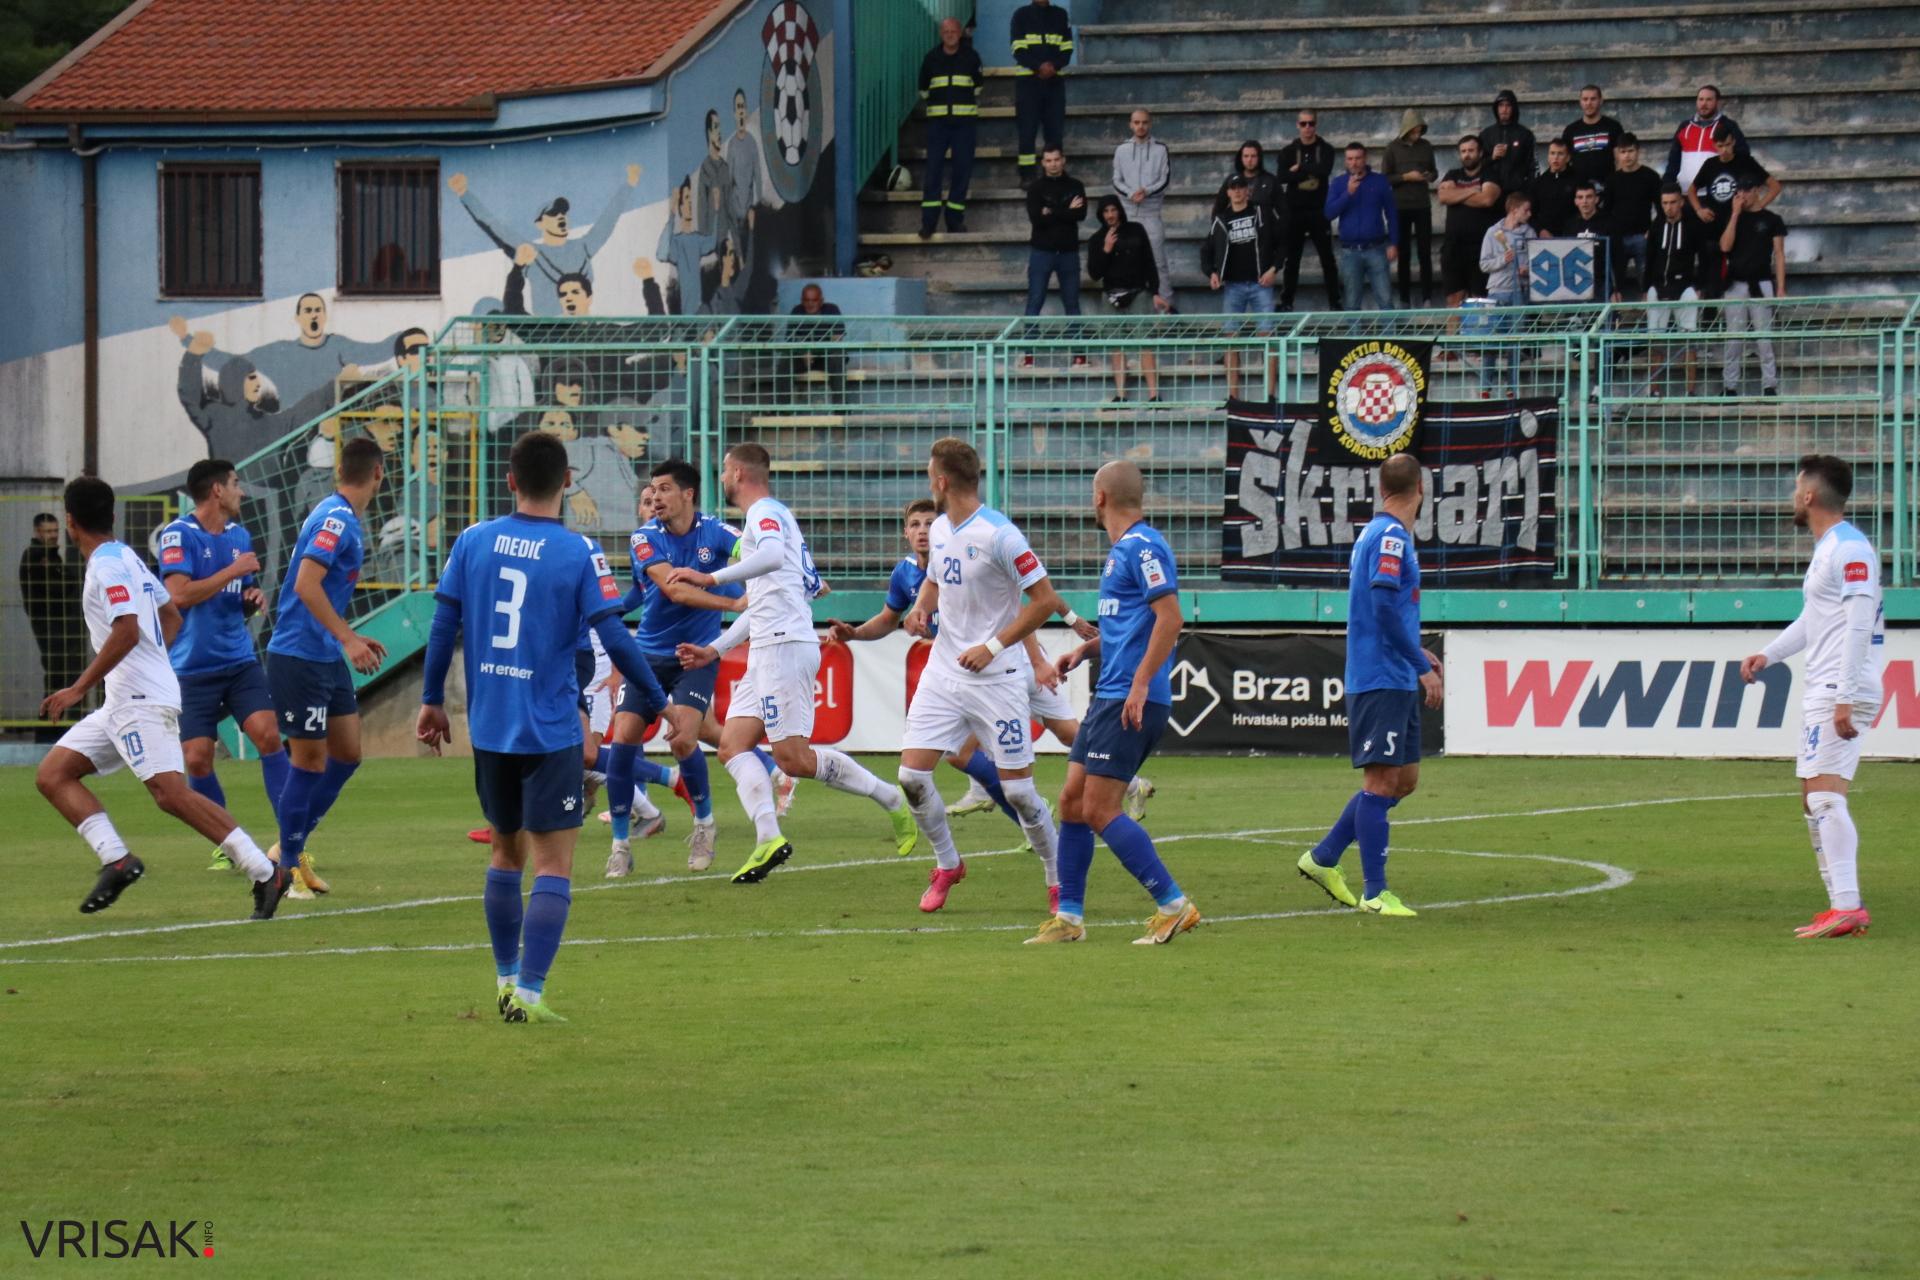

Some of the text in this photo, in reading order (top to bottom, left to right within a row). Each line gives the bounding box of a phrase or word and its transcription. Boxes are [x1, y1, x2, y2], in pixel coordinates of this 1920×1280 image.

[1530, 246, 1594, 298] 96
[1328, 368, 1345, 395] POD
[1340, 341, 1380, 369] SVETIM
[1328, 415, 1343, 434] DO
[494, 534, 546, 560] MEDIĆ
[943, 556, 962, 585] 29
[492, 566, 528, 650] 3
[480, 662, 495, 674] HT
[1233, 670, 1310, 701] Brza
[304, 706, 327, 731] 24
[995, 718, 1023, 746] 29
[1232, 713, 1288, 726] Hrvatska
[1291, 713, 1327, 728] pošta
[121, 731, 144, 761] 10
[1383, 731, 1398, 756] 5
